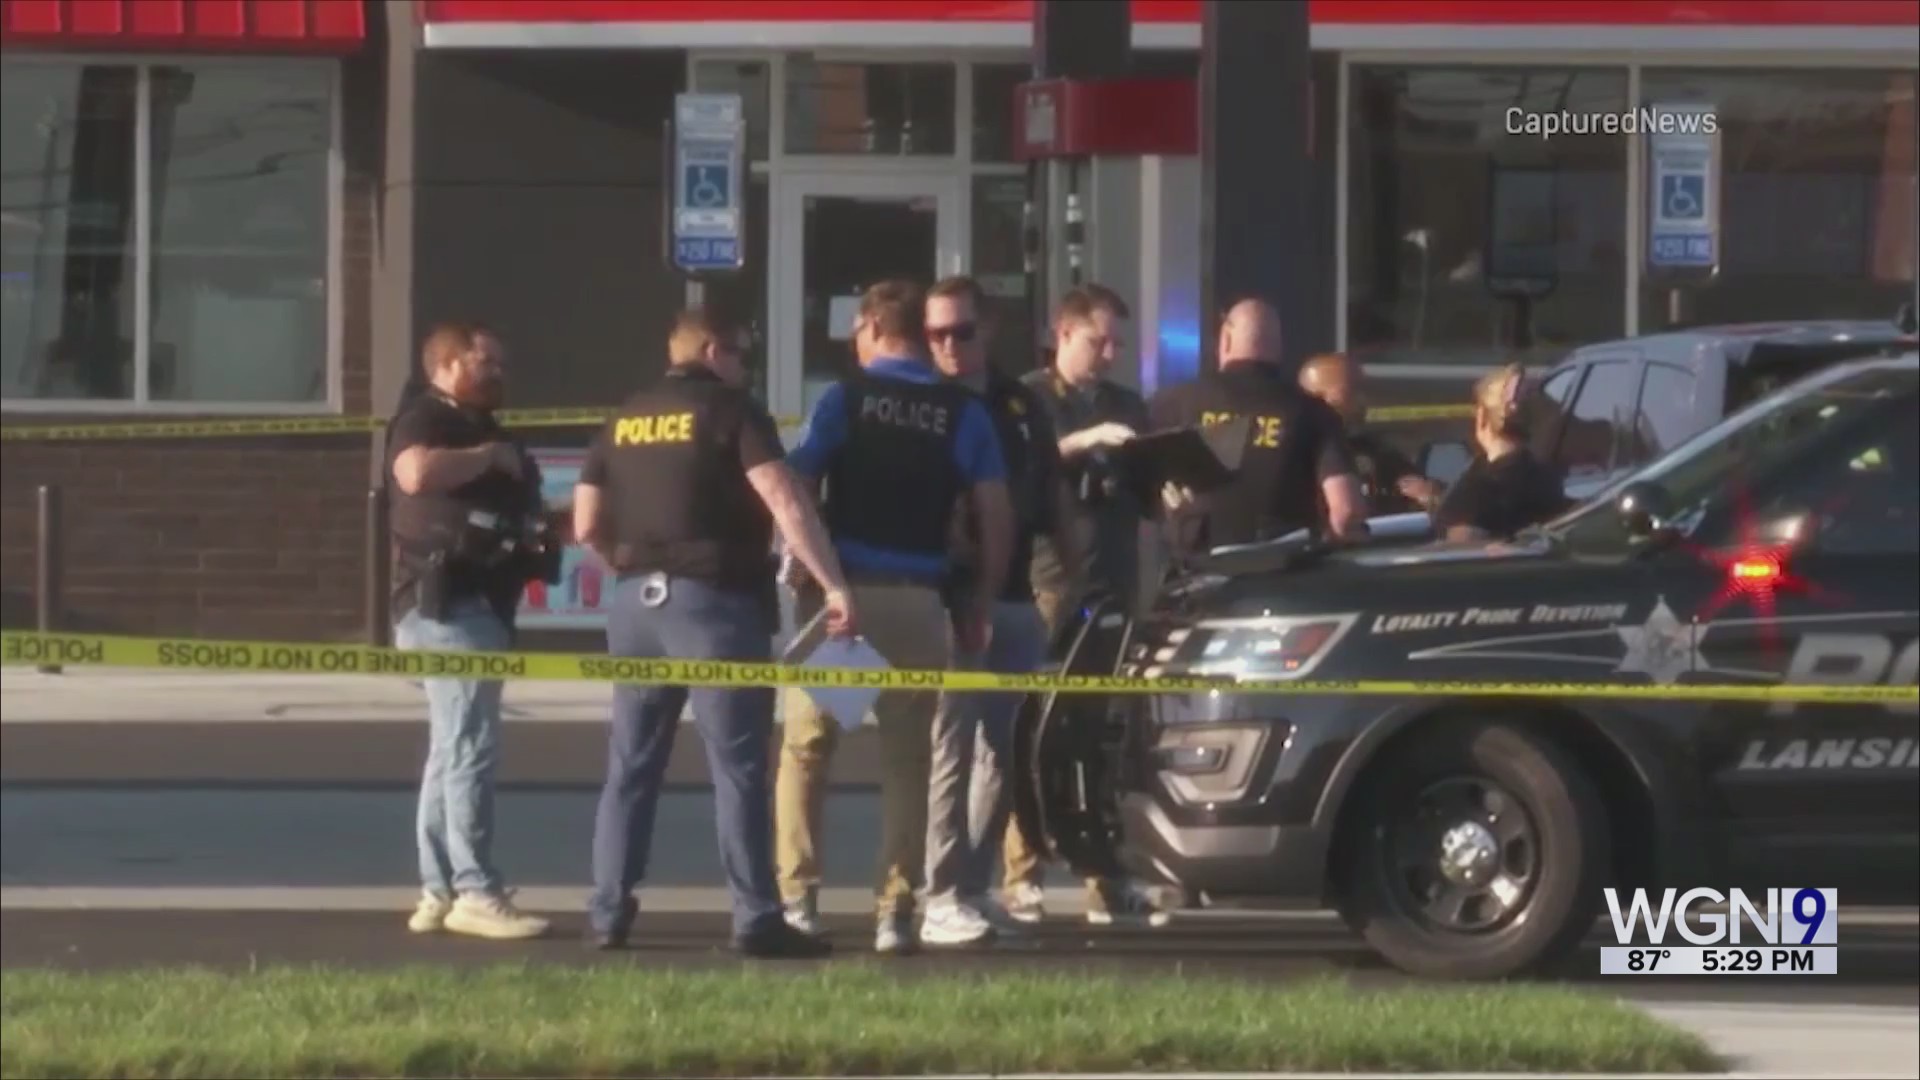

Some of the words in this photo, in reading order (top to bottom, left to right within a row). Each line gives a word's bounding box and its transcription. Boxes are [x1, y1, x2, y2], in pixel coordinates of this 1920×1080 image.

[861, 395, 948, 434] POLICE
[613, 411, 694, 446] POLICE
[1371, 612, 1459, 634] LOYALTY
[1461, 607, 1525, 626] PRIDE
[1530, 603, 1629, 624] DEVOTION
[7, 637, 104, 664] POLICE
[157, 640, 251, 667] CROSS
[260, 646, 313, 671] NOT
[319, 650, 359, 672] DO
[366, 651, 425, 674] LINE
[431, 652, 526, 676] POLICE
[578, 658, 673, 680] CROSS
[678, 661, 733, 681] NOT
